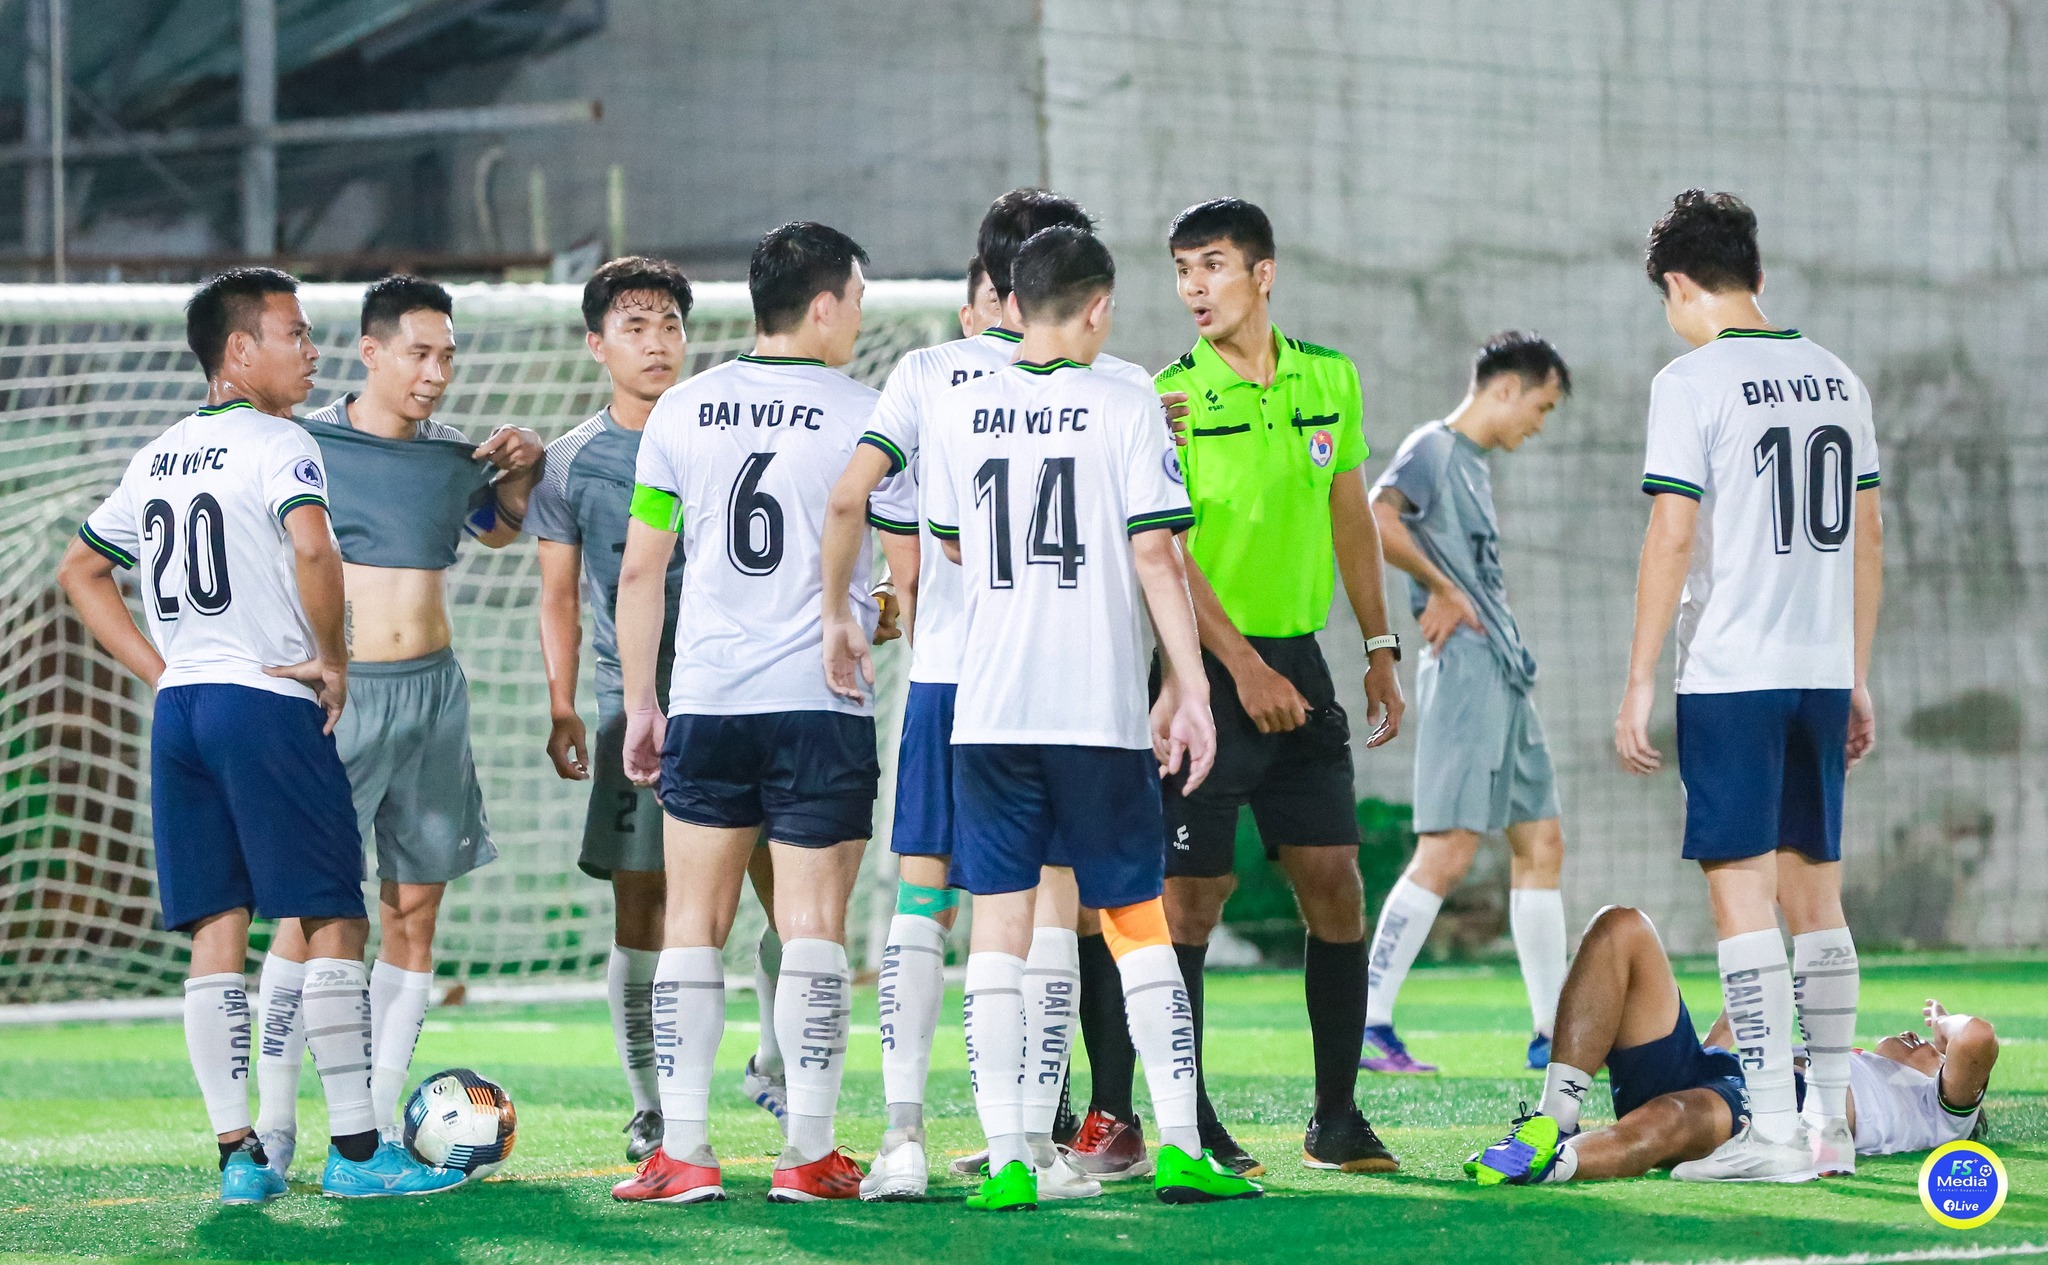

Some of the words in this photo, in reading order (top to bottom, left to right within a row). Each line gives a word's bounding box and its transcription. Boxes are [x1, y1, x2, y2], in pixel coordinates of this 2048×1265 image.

[1742, 379, 1784, 408] ĐẠI
[1788, 374, 1821, 402] VŨ
[1825, 378, 1849, 401] FC
[699, 402, 740, 430] ĐẠI
[751, 400, 784, 427] VŨ
[789, 405, 824, 430] FC
[973, 408, 1015, 438] ĐẠI
[1059, 408, 1089, 432] FC
[150, 453, 177, 481] ĐẠI
[202, 448, 227, 470] FC
[1754, 425, 1853, 554] 10
[727, 452, 784, 576] 6
[973, 457, 1086, 589] 14
[142, 492, 231, 621] 20
[801, 977, 841, 1008] ĐẠI
[1039, 981, 1073, 1016] ĐẠI
[1043, 1024, 1068, 1052] VŨ
[1733, 1011, 1770, 1041] VŨ
[263, 1036, 284, 1057] AN
[800, 1045, 832, 1070] FC
[1741, 1047, 1764, 1070] FC
[231, 1056, 249, 1080] FC
[656, 1054, 675, 1077] FC
[1039, 1060, 1061, 1085] FC
[1173, 1057, 1194, 1080] FC
